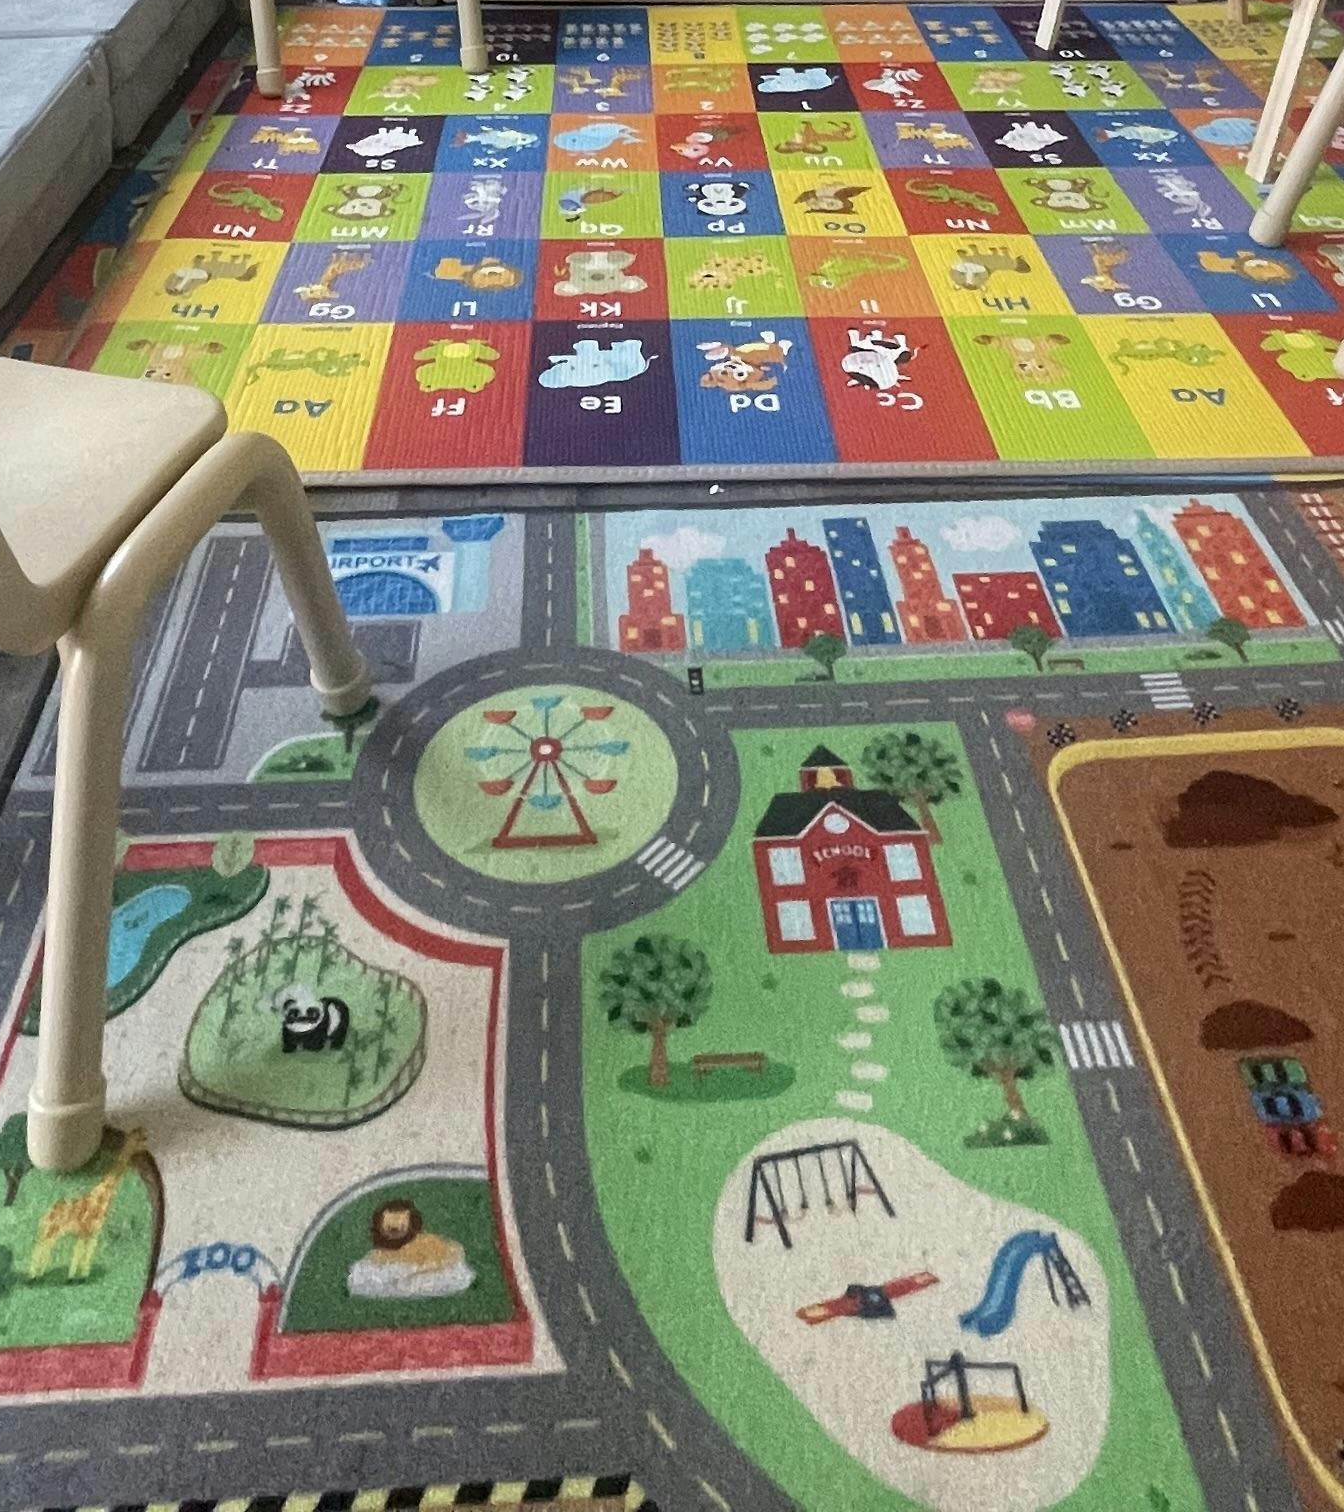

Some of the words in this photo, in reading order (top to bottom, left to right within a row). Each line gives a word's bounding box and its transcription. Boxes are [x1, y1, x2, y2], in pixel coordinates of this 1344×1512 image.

[280, 102, 311, 113] Zz
[384, 104, 413, 113] Yy
[893, 98, 924, 109] Zz
[997, 97, 1030, 107] Yy
[365, 157, 396, 170] Ss
[473, 156, 508, 168] Xx
[576, 157, 628, 168] Ww
[699, 156, 733, 167] Vv
[804, 155, 843, 166] Uu
[922, 154, 950, 165] Tt
[1029, 153, 1063, 165] Ss
[1133, 151, 1172, 163] Xx
[251, 158, 279, 170] Tt
[581, 220, 624, 237] Qq
[707, 220, 745, 234] Pp
[824, 222, 866, 234] Oo
[945, 218, 990, 231] Nn
[1060, 218, 1115, 232] Mm
[1191, 217, 1222, 230] Rr
[212, 224, 256, 238] Nn
[331, 225, 389, 238] Mm
[463, 224, 494, 237] Rr
[726, 296, 747, 313] Jj
[861, 299, 878, 313] Ii
[983, 297, 1030, 310] Hh
[1112, 292, 1162, 310] Gg
[172, 303, 219, 318] Hh
[308, 303, 355, 319] Gg
[580, 301, 621, 316] Kk
[730, 394, 779, 412] Dd
[877, 392, 923, 410] Cc
[1025, 389, 1081, 408] Bb
[1172, 388, 1226, 406] Aa
[274, 399, 333, 417] Aa
[432, 397, 465, 417] Ff
[580, 396, 621, 413] Ee
[330, 555, 415, 569] IRPORT
[183, 1242, 256, 1278] ZOO
